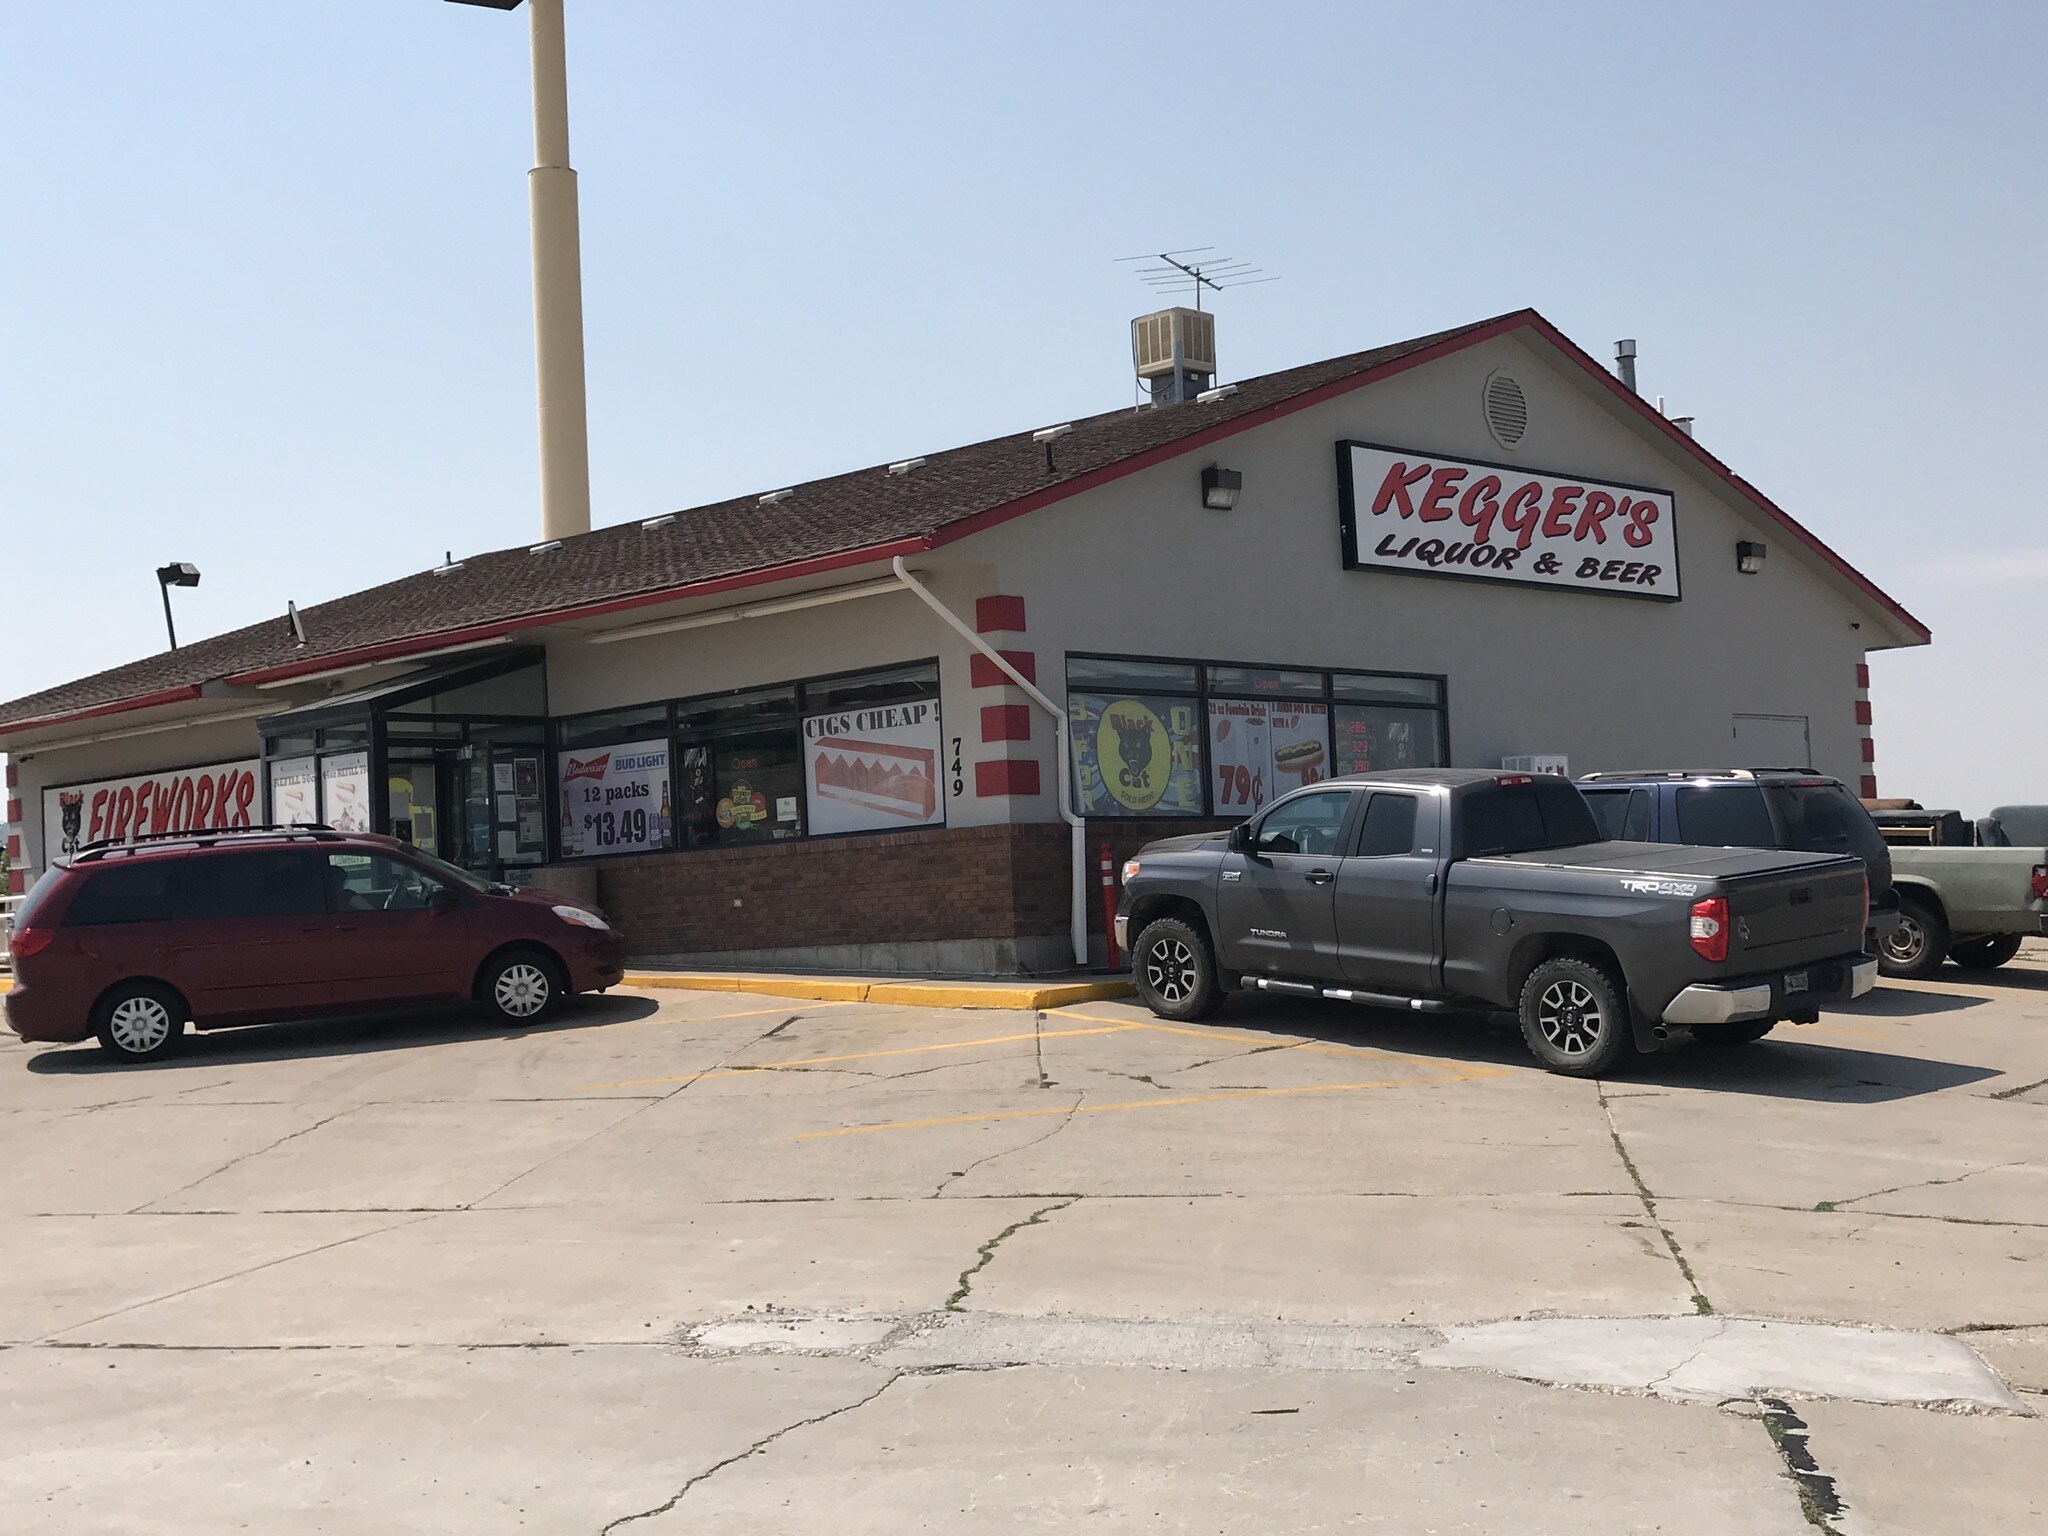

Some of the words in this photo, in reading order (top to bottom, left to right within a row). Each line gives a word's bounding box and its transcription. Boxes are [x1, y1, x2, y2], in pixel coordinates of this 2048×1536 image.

[1371, 461, 1660, 550] KEGGER'S
[1374, 533, 1522, 571] LIQUOR
[1532, 552, 1563, 575] &
[1575, 557, 1662, 586] BEER
[805, 714, 851, 738] CIGS
[856, 704, 928, 732] CHEAP
[1109, 713, 1155, 733] Black
[566, 761, 608, 777] Budweiser
[615, 757, 635, 771] BUD
[636, 753, 666, 768] LIGHT
[732, 757, 758, 769] Open
[273, 774, 301, 788] REFILL
[1119, 767, 1151, 789] Cat
[584, 786, 601, 802] 12
[605, 781, 650, 805] packs
[1120, 790, 1138, 804] SOLD
[1139, 790, 1155, 805] HERE
[87, 769, 255, 846] FIREWORKS
[584, 808, 647, 846] $13.49
[1250, 928, 1288, 939] TUNDRA
